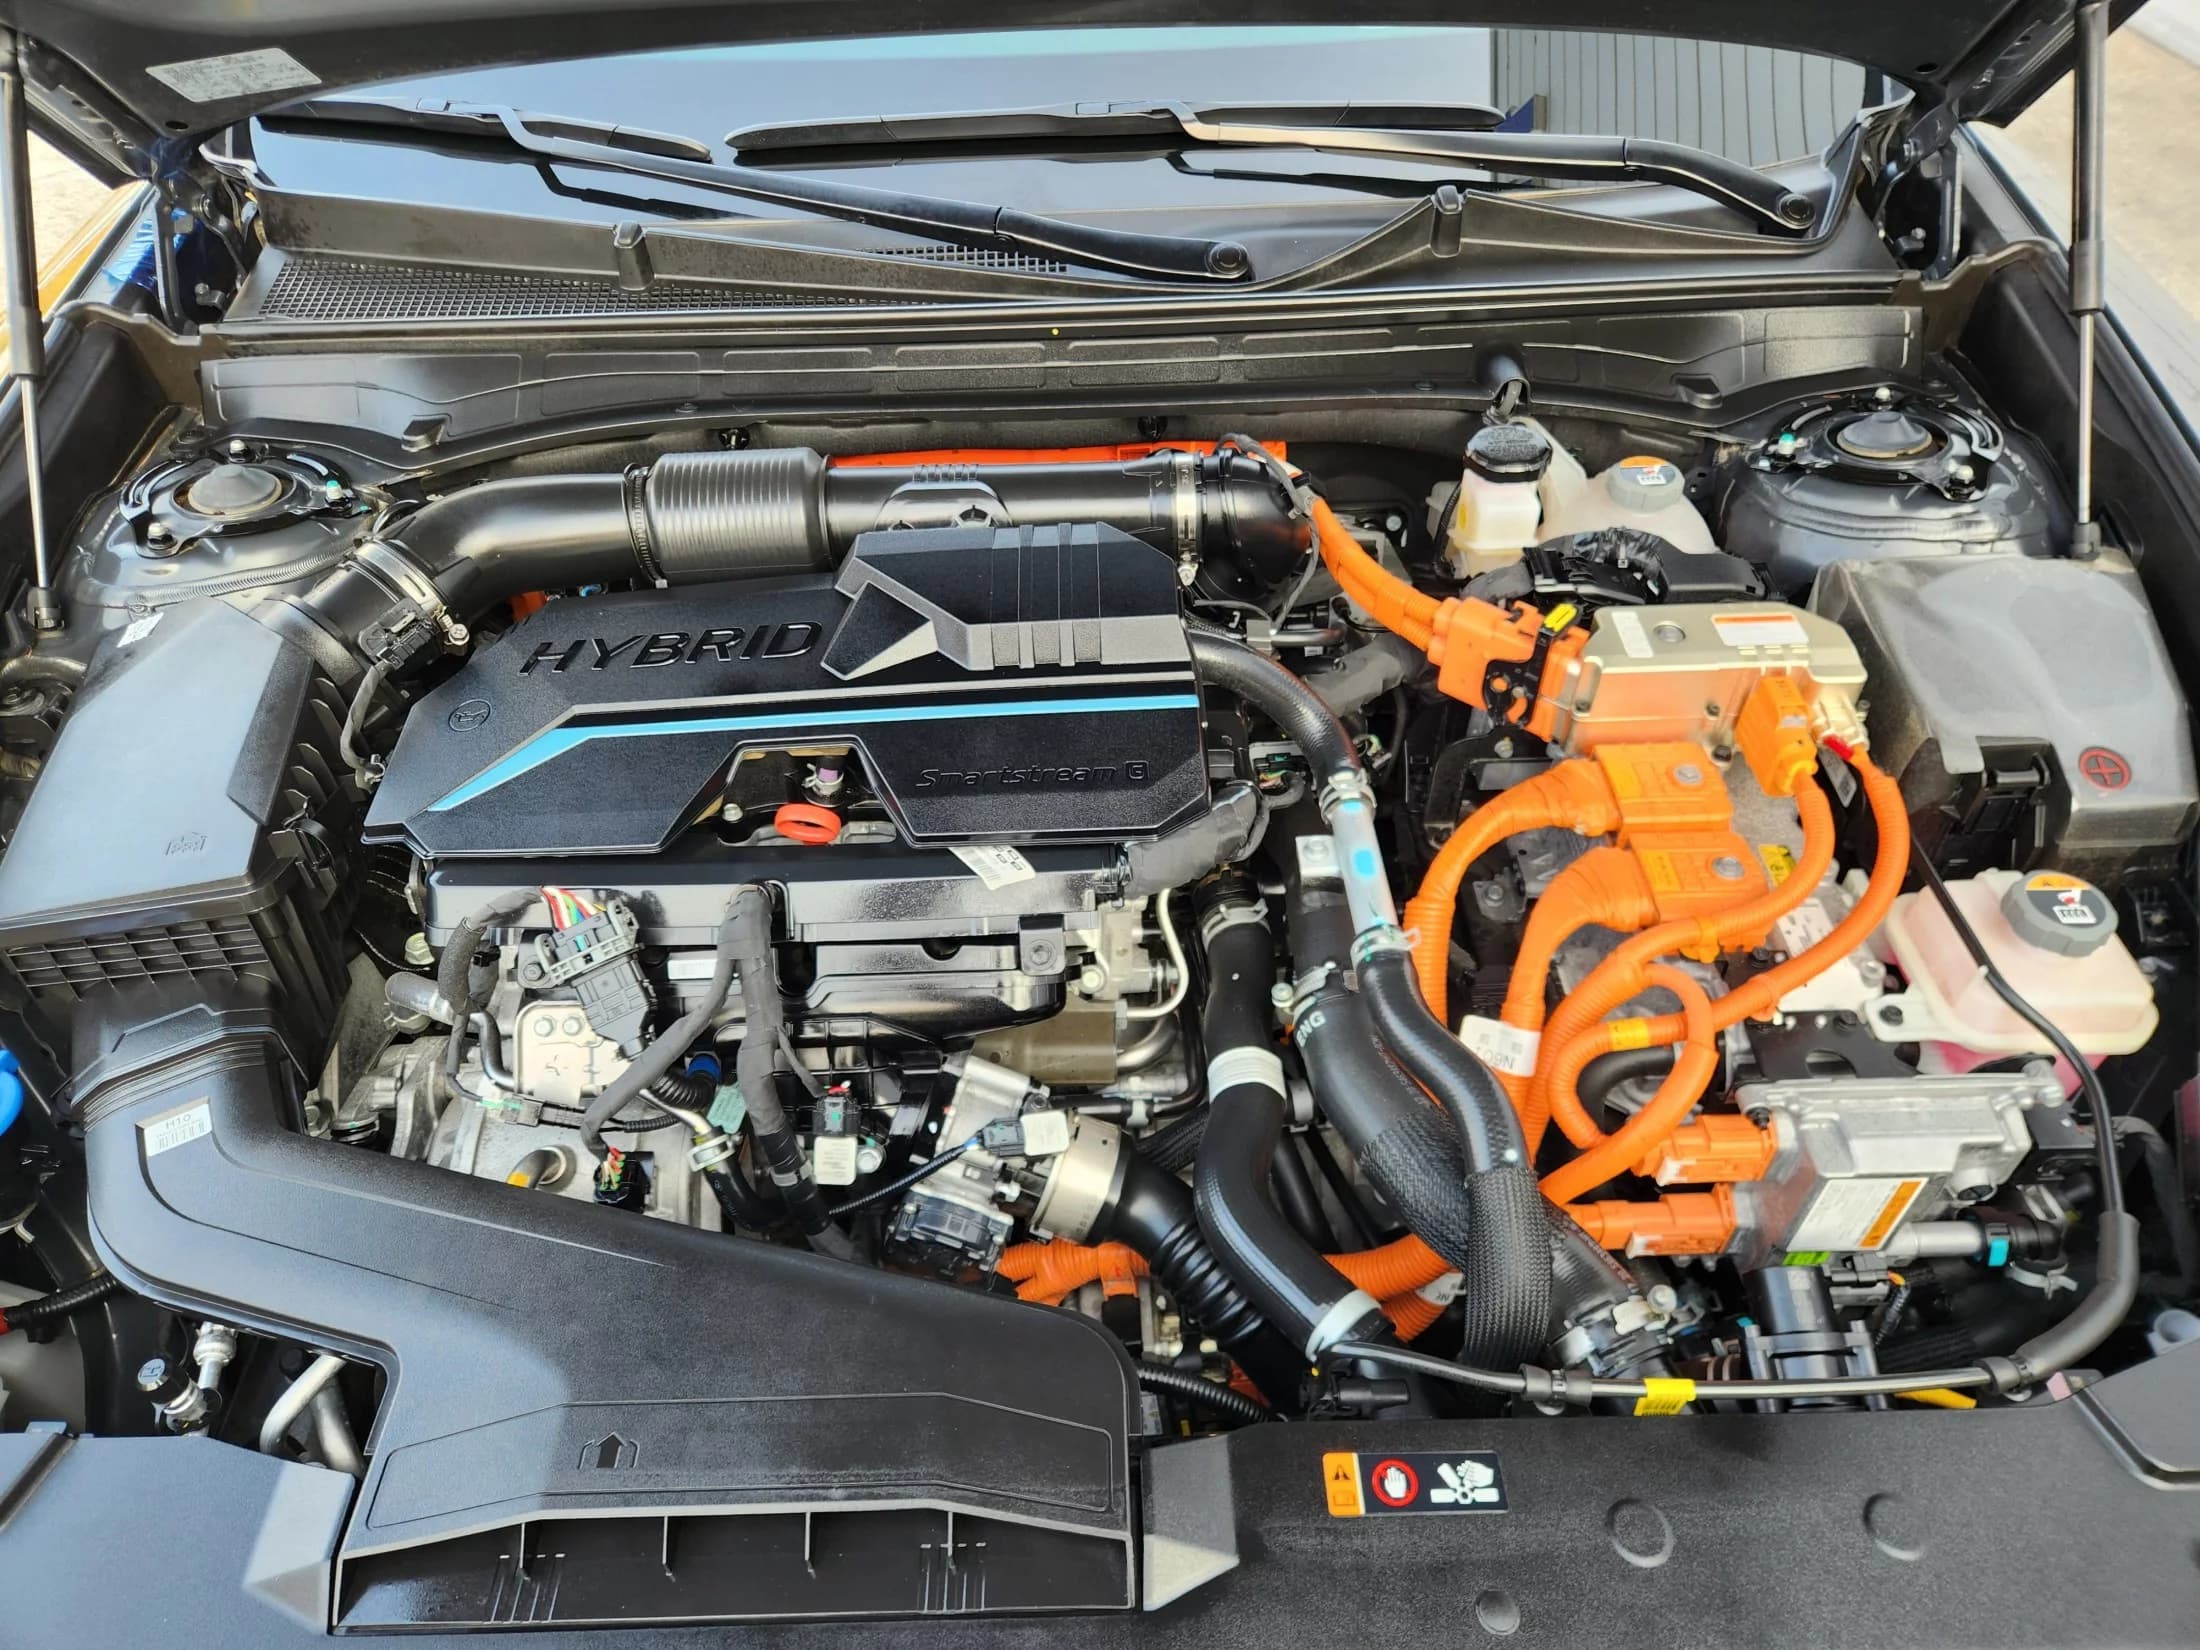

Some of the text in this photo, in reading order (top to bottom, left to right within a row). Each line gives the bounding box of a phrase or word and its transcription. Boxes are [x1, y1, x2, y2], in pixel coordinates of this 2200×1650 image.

[517, 620, 823, 676] HYBRID
[915, 764, 1118, 787] Smartstream
[1296, 1010, 1327, 1048] ENG
